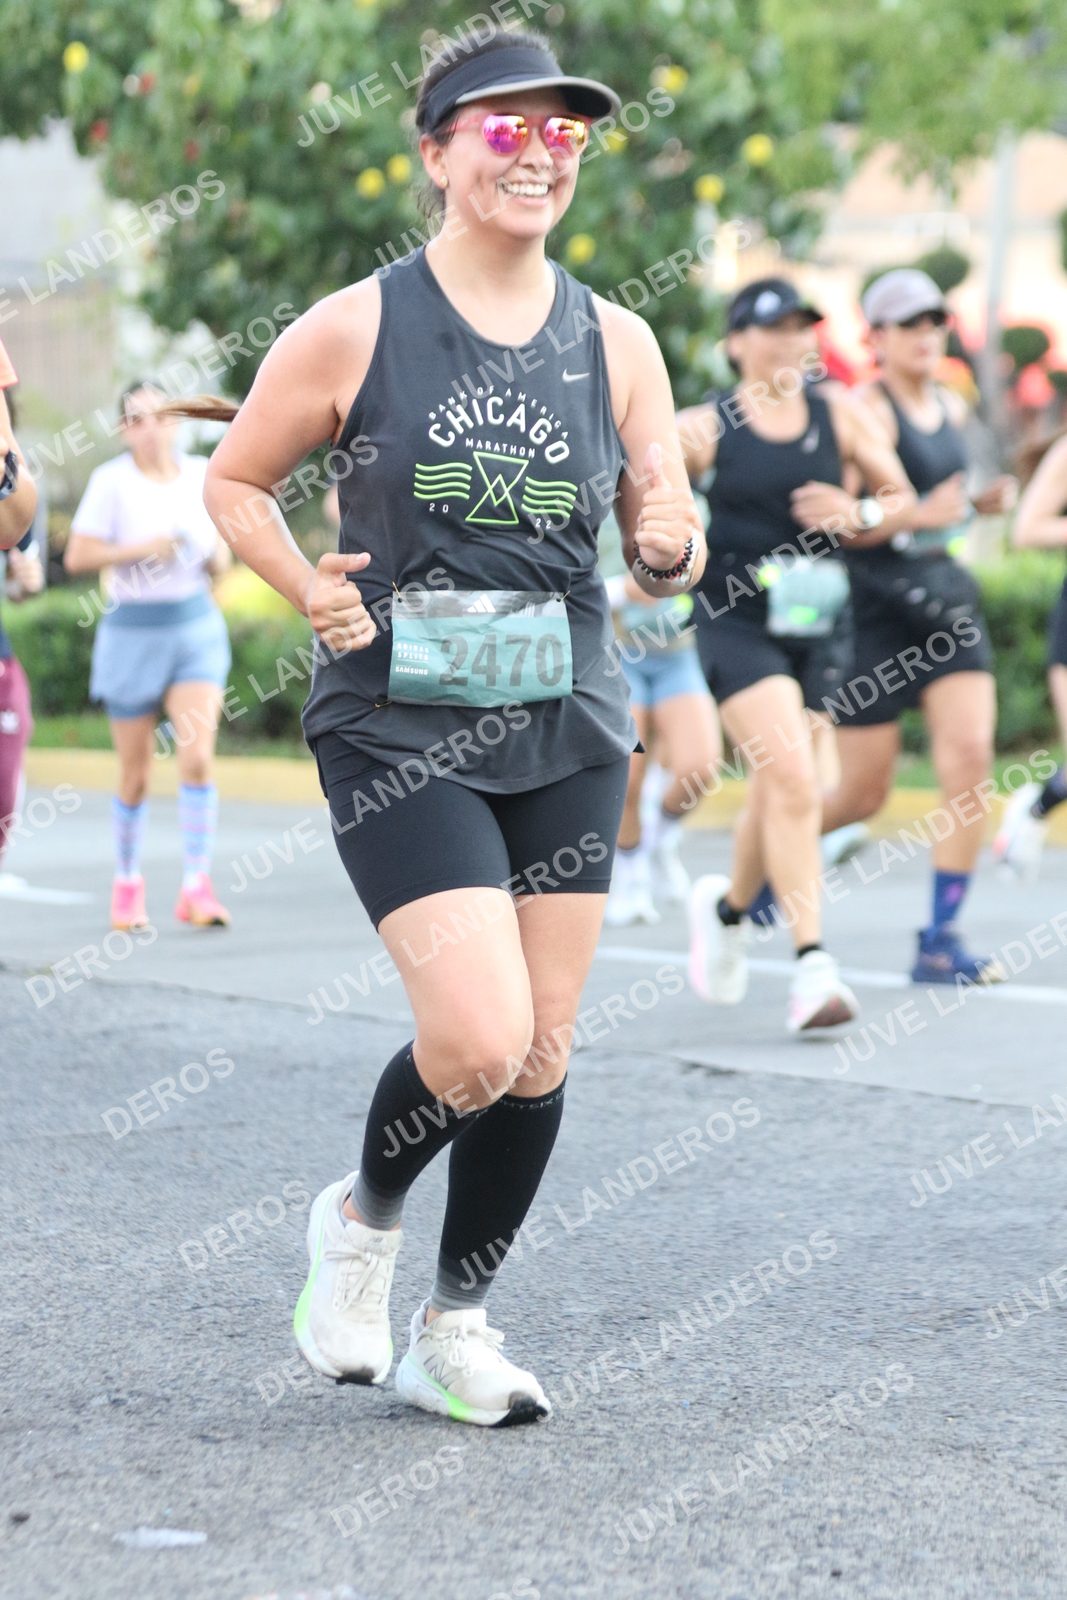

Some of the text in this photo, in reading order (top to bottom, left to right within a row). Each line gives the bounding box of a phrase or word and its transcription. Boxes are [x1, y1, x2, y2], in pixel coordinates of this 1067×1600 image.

[428, 385, 569, 440] BANK OF AMERICA
[428, 396, 570, 464] CHICAGO
[465, 438, 536, 459] MARATHON
[395, 666, 428, 676] SAMSUNG
[439, 633, 564, 687] 2470
